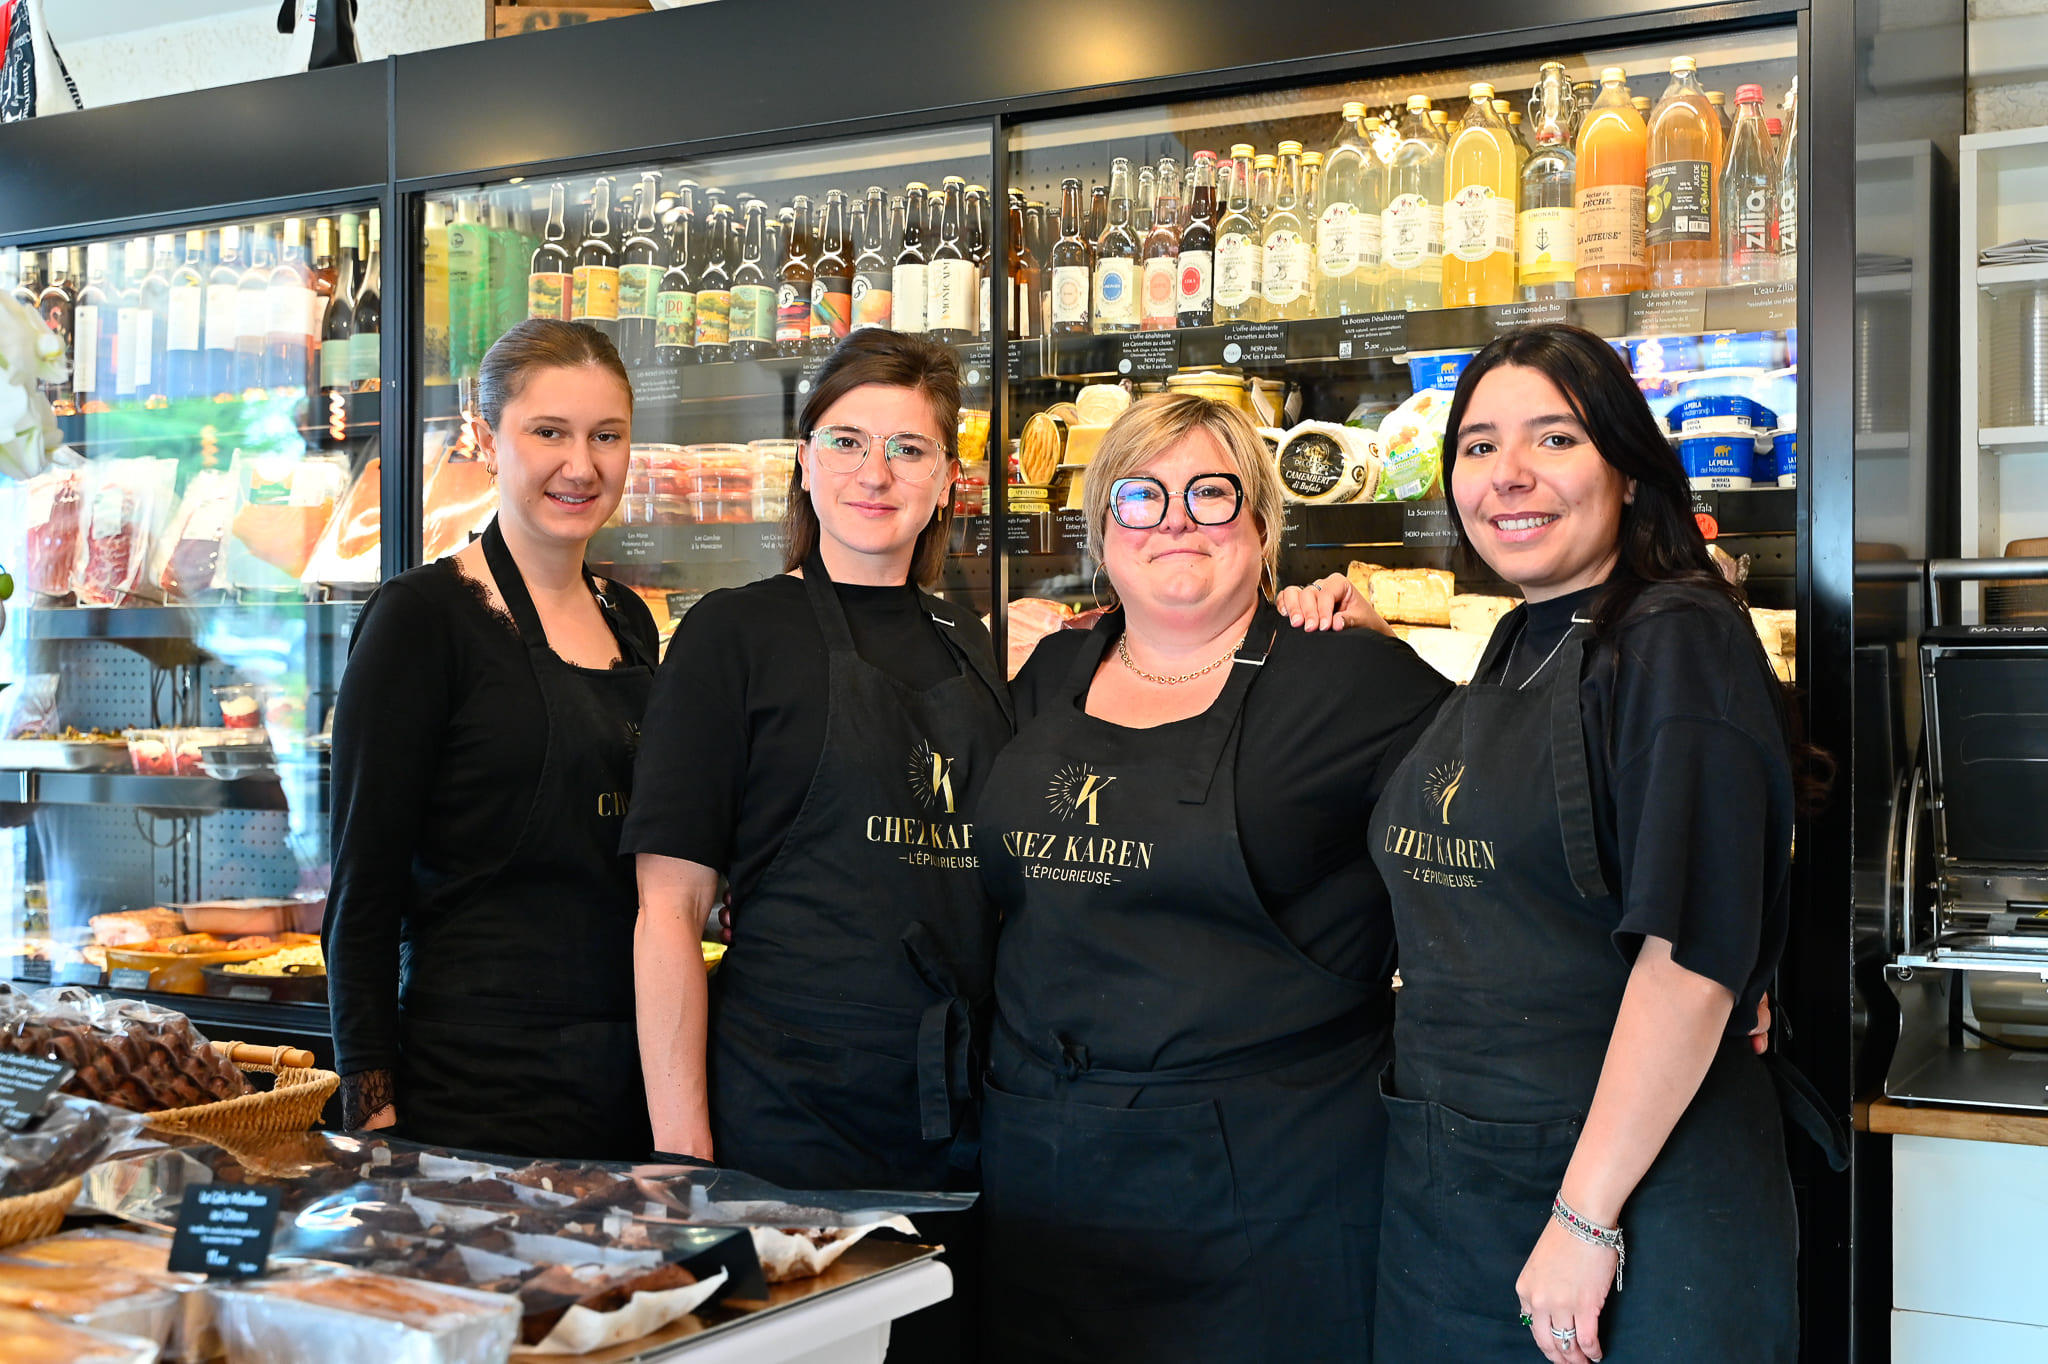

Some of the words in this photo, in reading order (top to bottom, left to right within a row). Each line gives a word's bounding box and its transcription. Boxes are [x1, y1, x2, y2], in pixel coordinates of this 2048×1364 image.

[1700, 164, 1709, 214] POMMES
[1740, 189, 1765, 248] zilia
[665, 299, 683, 315] IPA
[1717, 459, 1733, 467] PERLA
[1286, 470, 1330, 485] CAMEMBERT
[1300, 482, 1321, 493] Bufala
[1075, 774, 1117, 826] K
[1064, 835, 1154, 870] KAREN
[1384, 825, 1433, 862] CHEZ
[1436, 835, 1496, 870] KAREN
[1025, 863, 1111, 885] L'ÉPICURIEUSE
